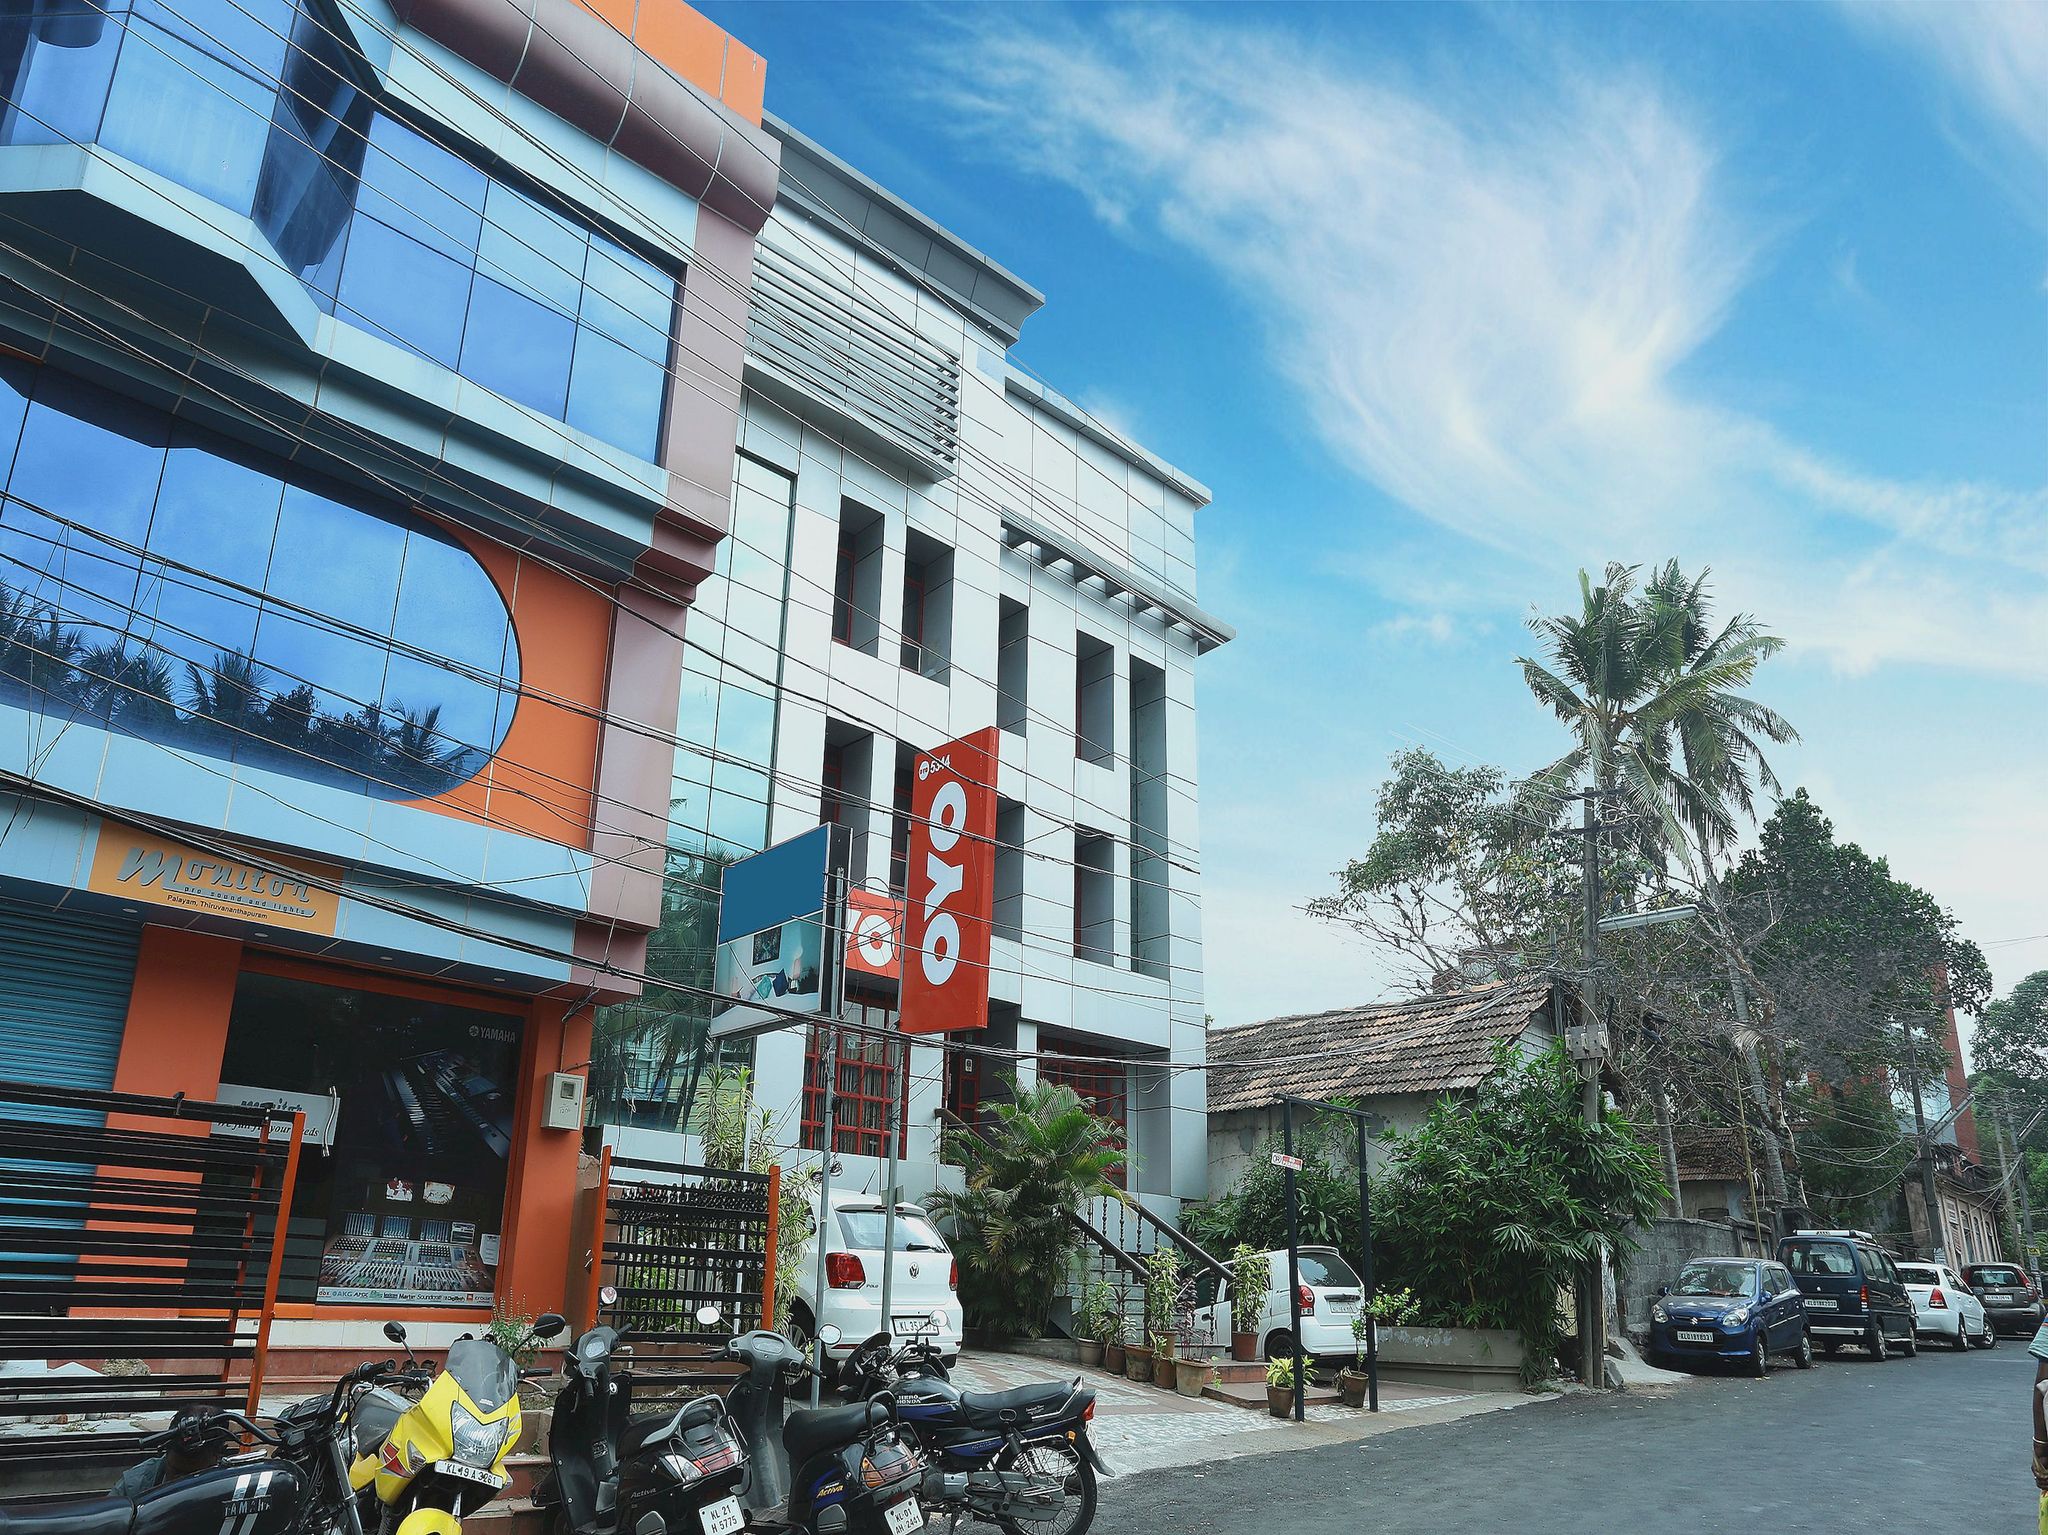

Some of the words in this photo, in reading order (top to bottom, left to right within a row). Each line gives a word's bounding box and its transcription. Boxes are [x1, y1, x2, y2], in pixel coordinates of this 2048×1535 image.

[921, 781, 967, 986] OYO
[167, 894, 198, 908] Palayam,
[200, 900, 268, 919] Thiruvananthapuram
[184, 886, 202, 896] pro
[209, 890, 242, 902] sound
[248, 898, 267, 908] and
[273, 902, 305, 915] lights
[480, 1026, 516, 1044] YAMAHA
[270, 1124, 292, 1134] your
[446, 1463, 457, 1475] KL
[816, 1485, 844, 1499] Activa
[711, 1509, 721, 1521] KL
[722, 1504, 732, 1516] 21
[711, 1522, 719, 1534] H
[719, 1515, 738, 1531] 5775
